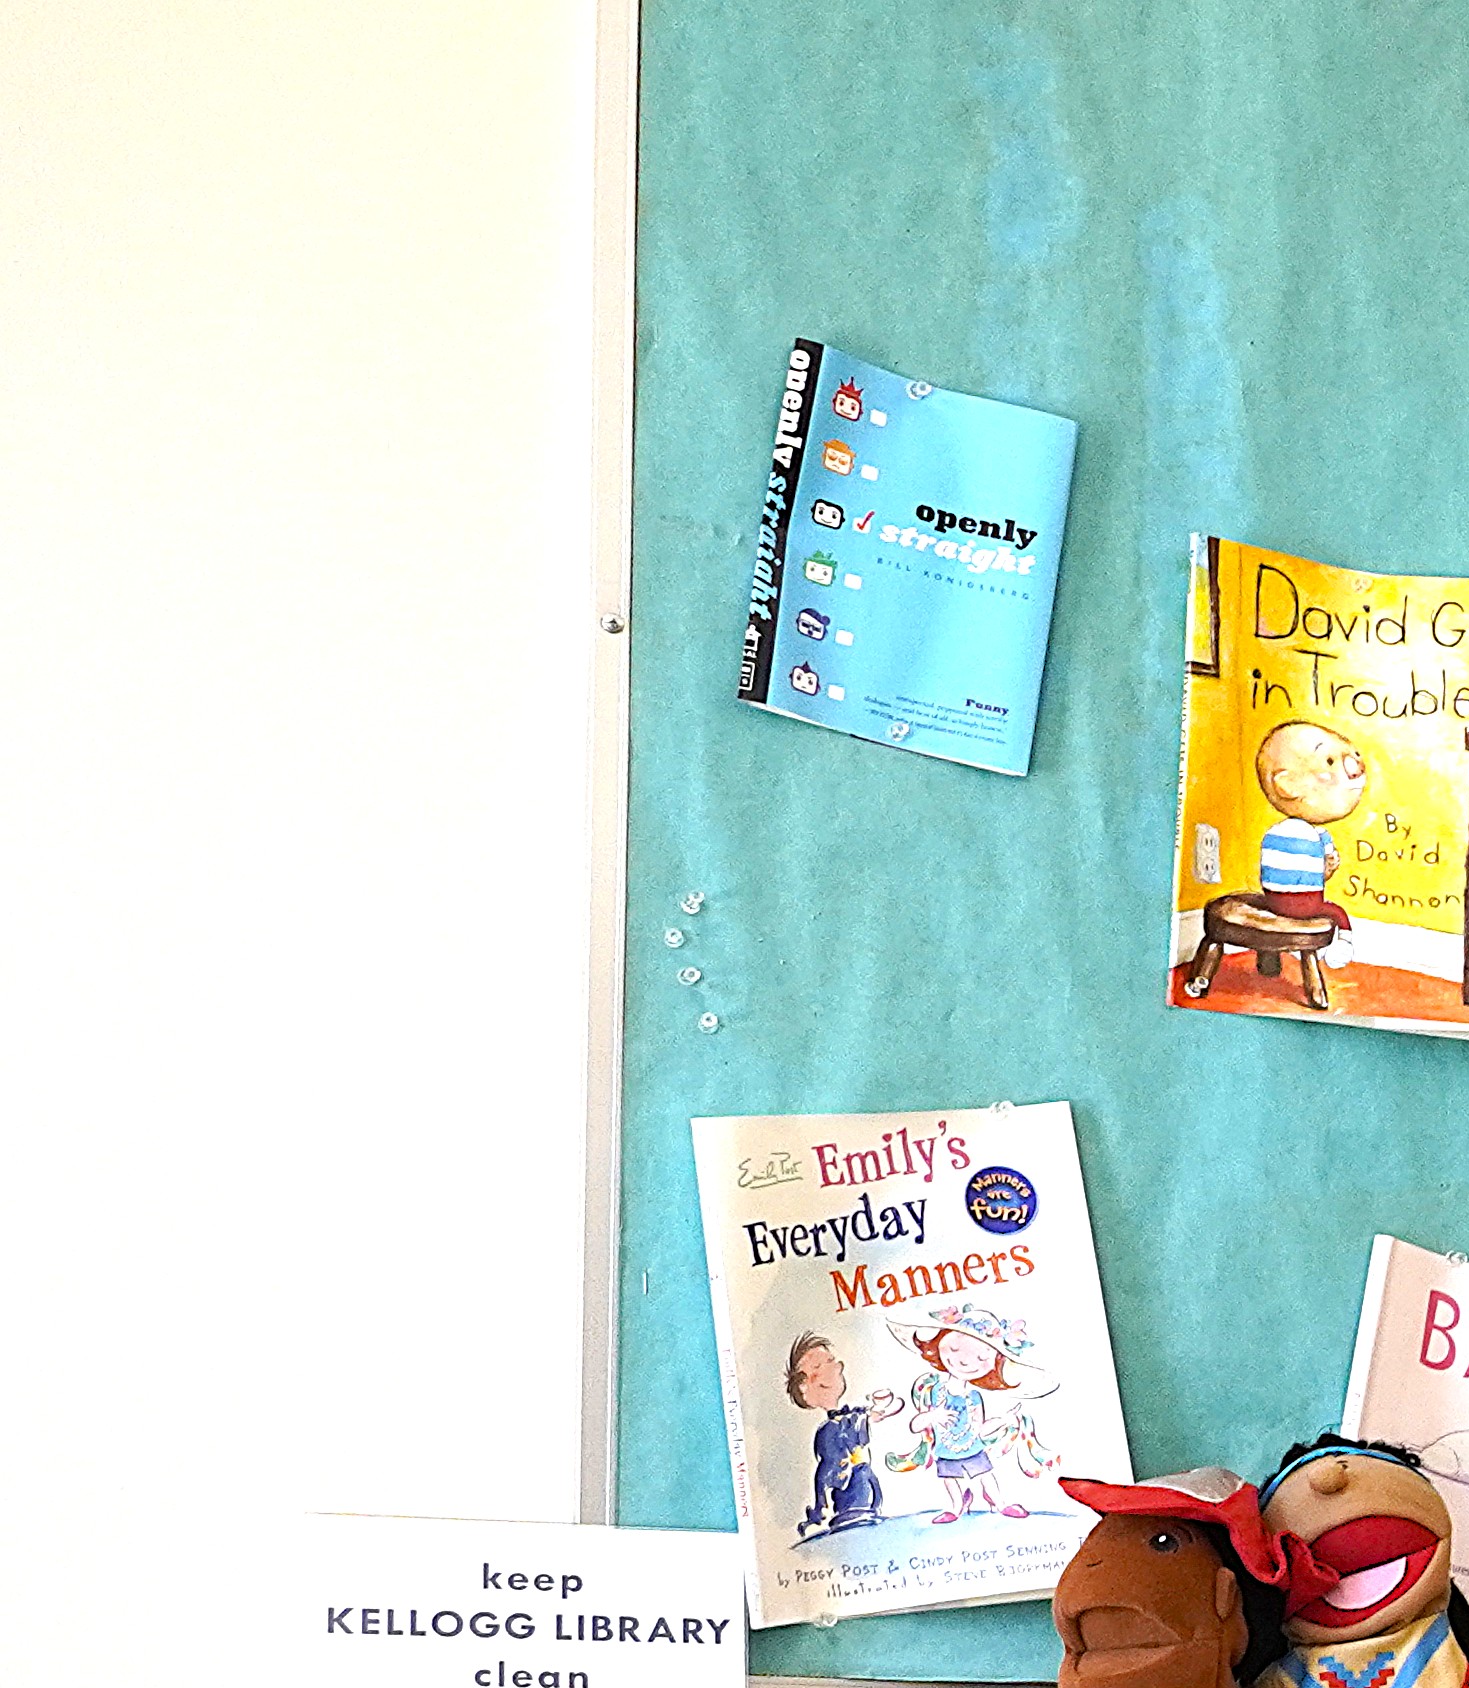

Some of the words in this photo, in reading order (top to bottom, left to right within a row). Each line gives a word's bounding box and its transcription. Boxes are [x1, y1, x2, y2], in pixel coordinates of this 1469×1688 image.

[916, 504, 1038, 550] openly
[879, 525, 1037, 575] straight
[1254, 564, 1408, 646] David
[1251, 668, 1292, 710] in
[1385, 813, 1412, 838] By
[1356, 839, 1440, 864] David
[1343, 876, 1462, 908] Shannon
[811, 1121, 971, 1188] Emily's
[742, 1192, 927, 1267] Everyday
[971, 1198, 1029, 1224] fun!
[829, 1245, 1035, 1313] Manners
[482, 1563, 584, 1599] keep
[841, 1563, 878, 1578] POST
[909, 1555, 953, 1571] CINDY
[326, 1606, 536, 1640] KELLOGG
[555, 1613, 731, 1645] LIBRARY
